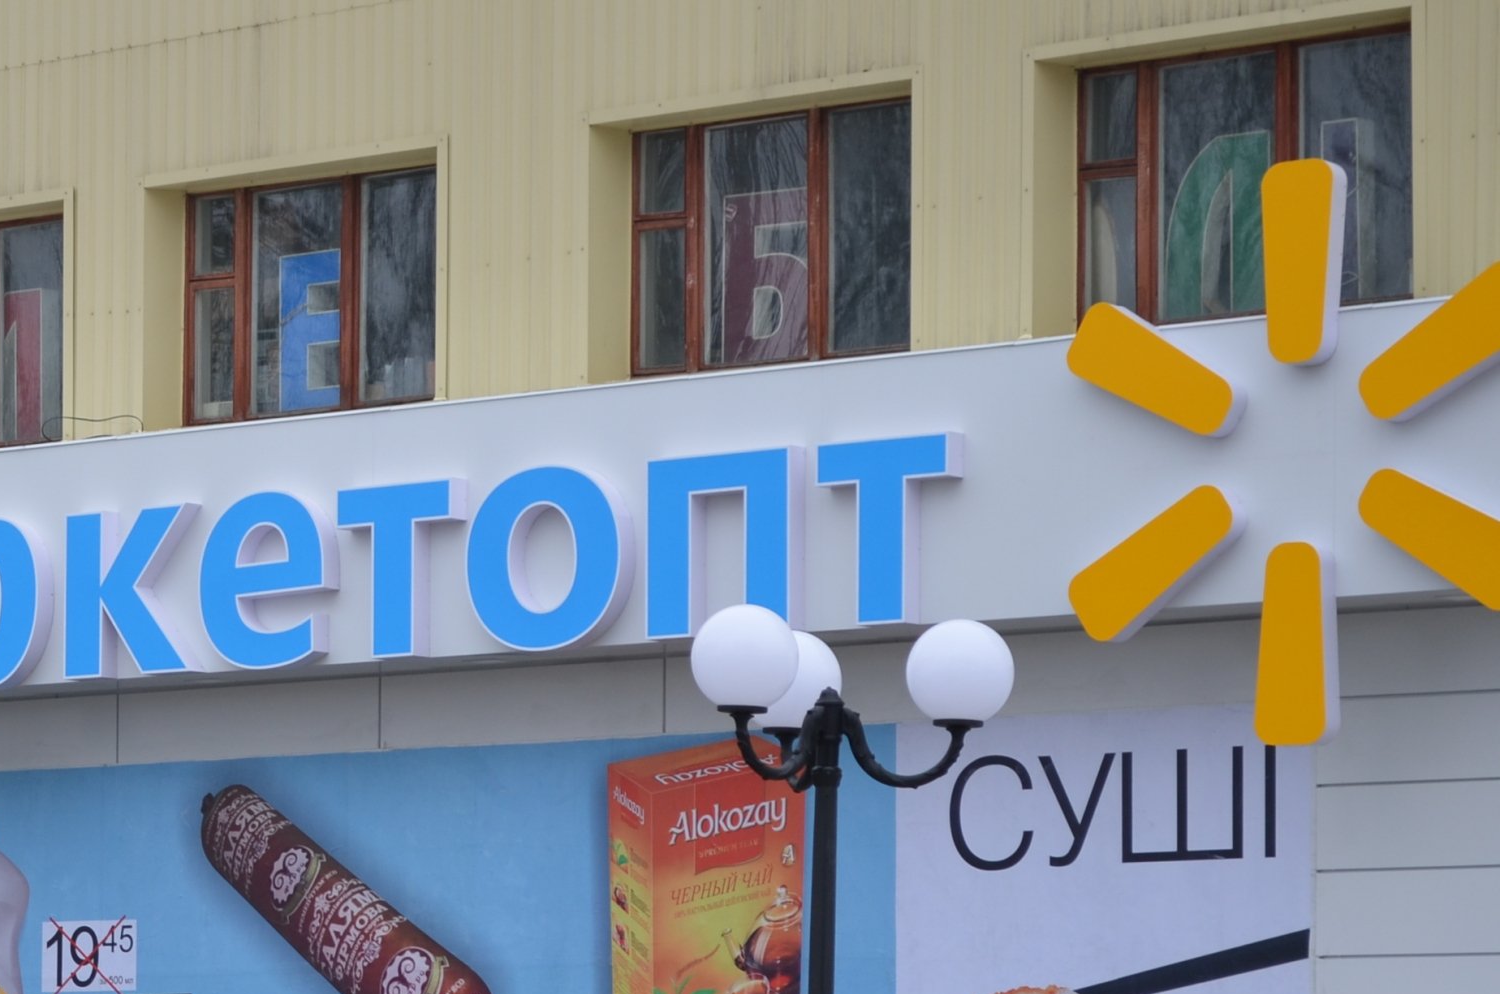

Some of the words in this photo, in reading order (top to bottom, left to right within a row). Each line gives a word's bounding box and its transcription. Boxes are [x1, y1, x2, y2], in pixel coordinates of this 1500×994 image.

[668, 796, 787, 846] Alokozay
[949, 744, 1277, 871] СУШІ
[671, 872, 738, 907] ЧЕРНЫЙ
[742, 864, 774, 889] ЧАЙ
